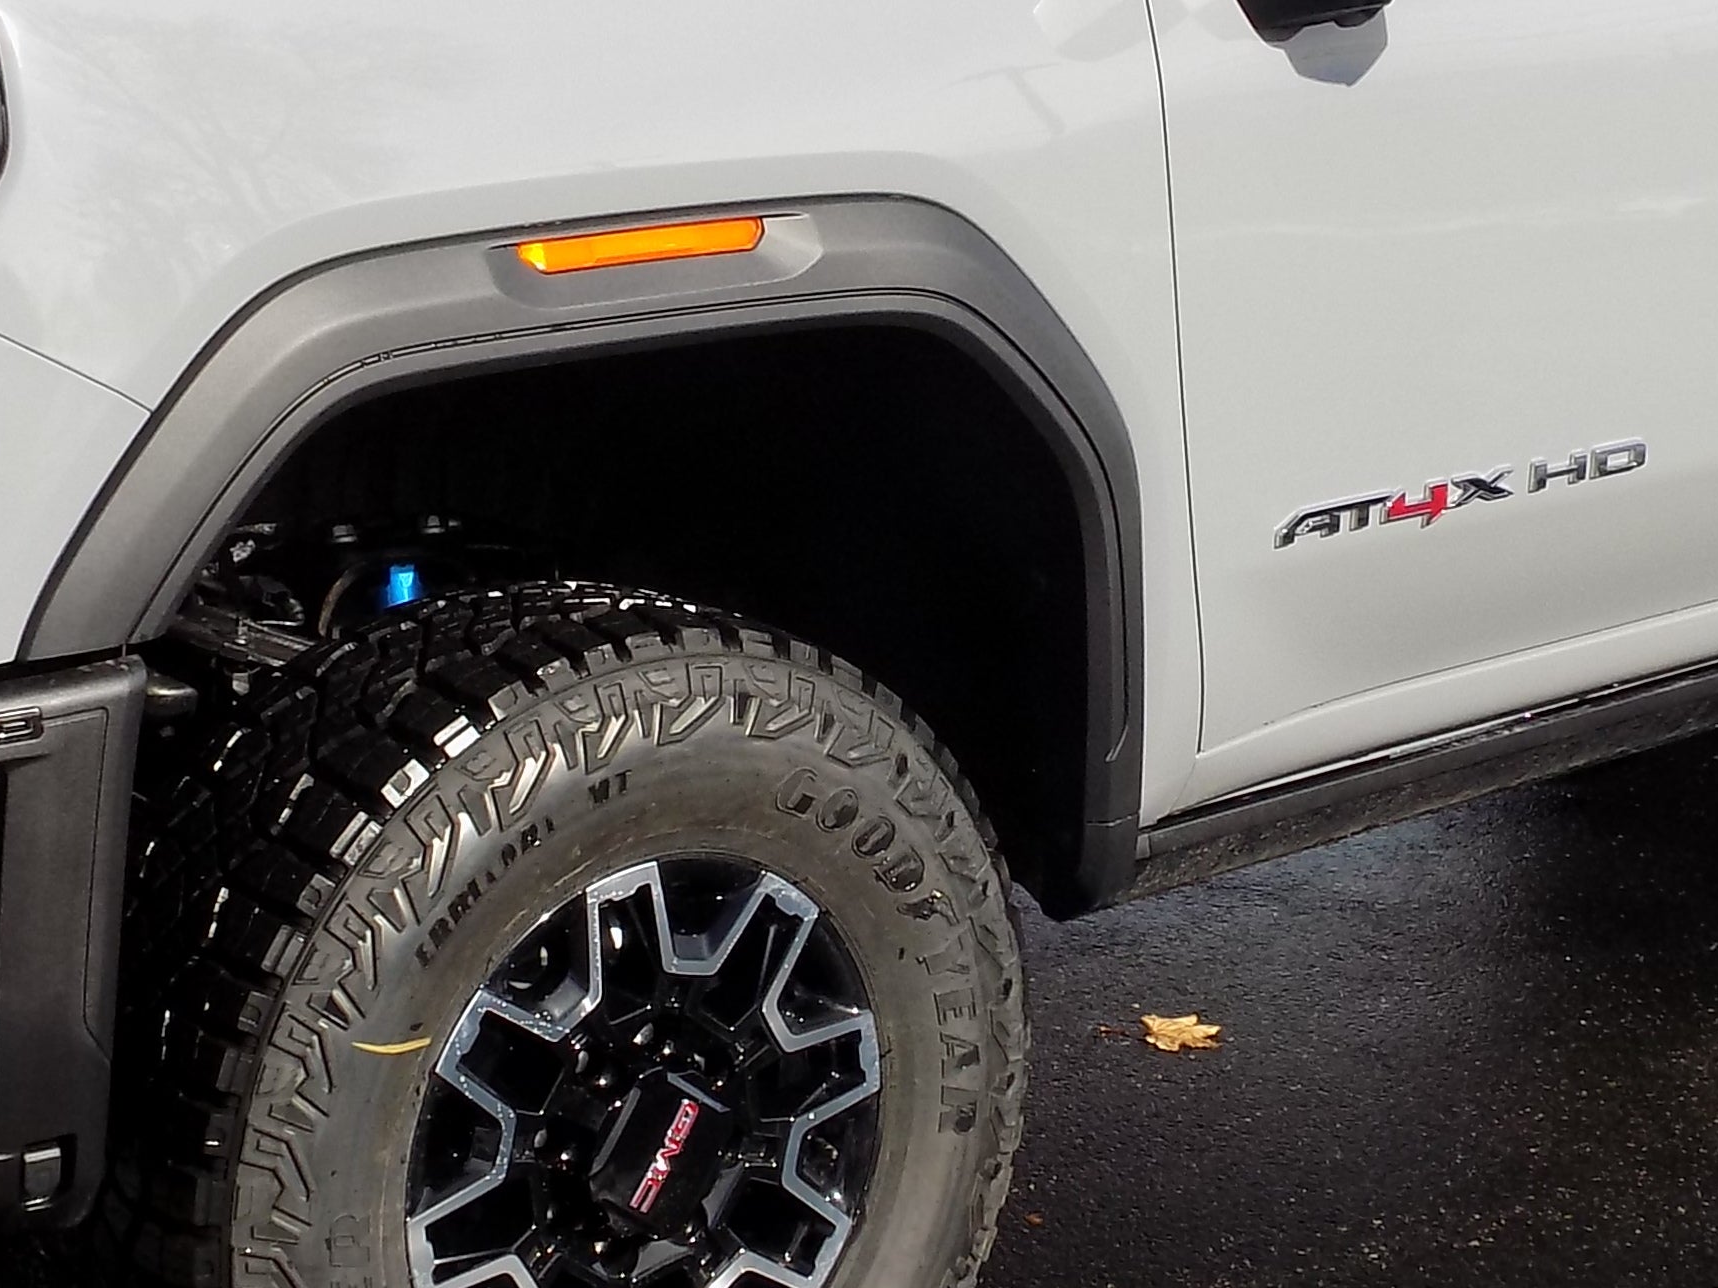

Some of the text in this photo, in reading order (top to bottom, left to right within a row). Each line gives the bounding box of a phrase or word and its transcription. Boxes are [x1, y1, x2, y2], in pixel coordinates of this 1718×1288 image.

[1272, 436, 1649, 550] AT4X HD
[776, 767, 979, 1133] GOODYEAR
[628, 1099, 700, 1213] GMC
